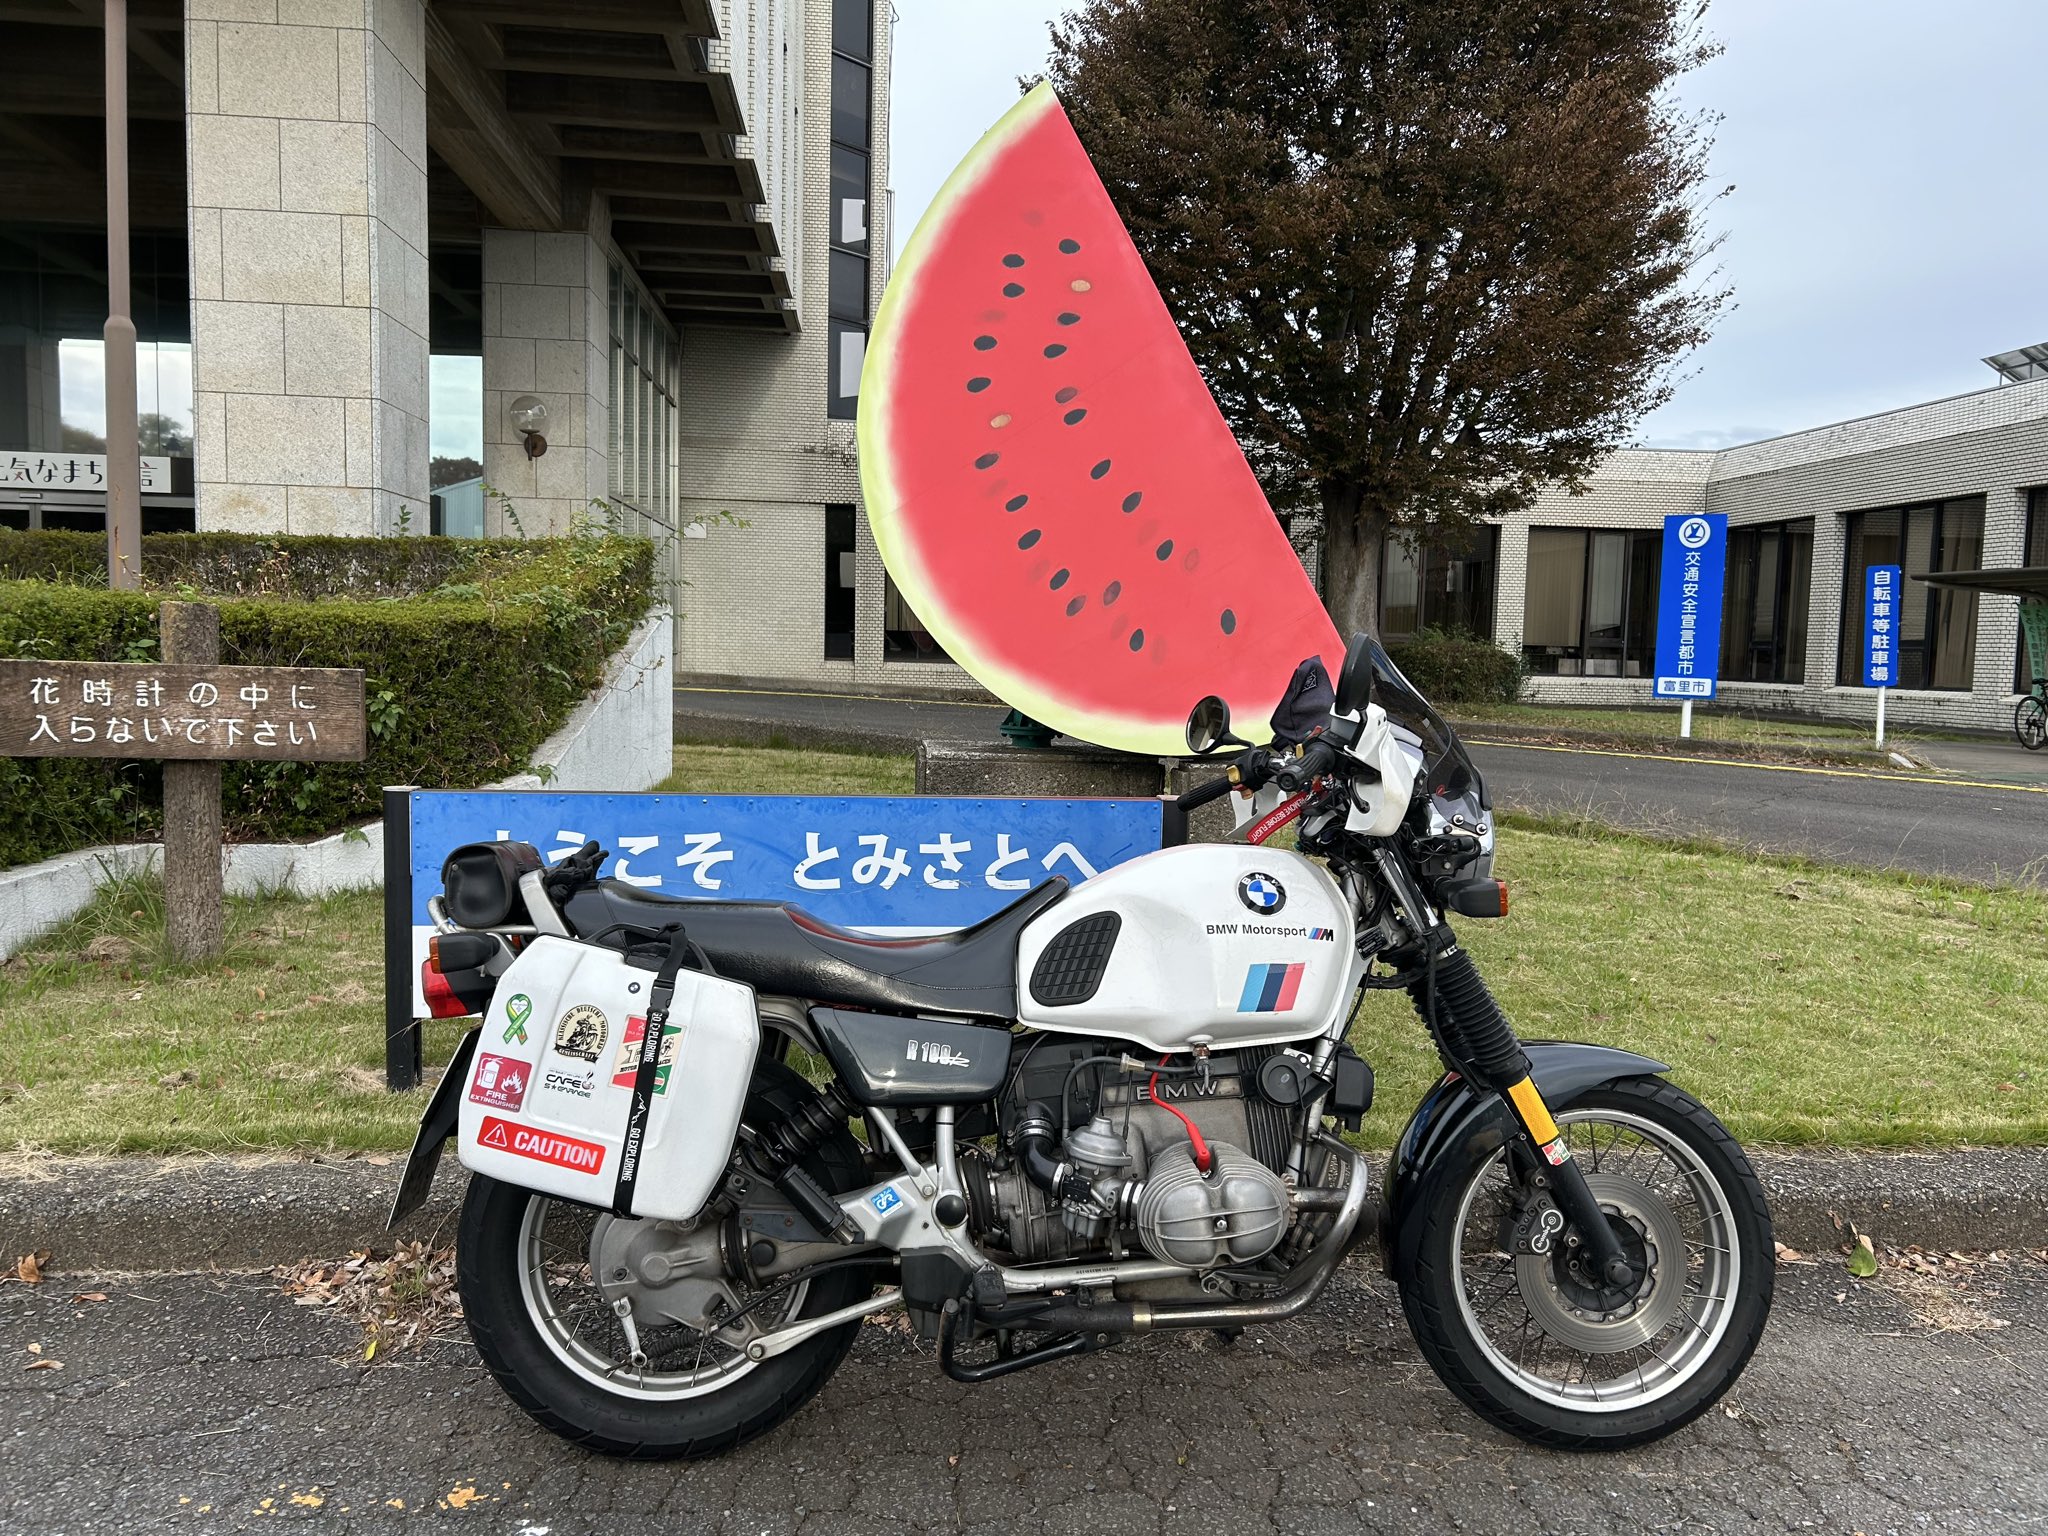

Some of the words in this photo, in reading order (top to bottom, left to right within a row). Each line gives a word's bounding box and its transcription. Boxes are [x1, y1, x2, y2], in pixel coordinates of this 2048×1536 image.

[1677, 551, 1701, 675] 交通安全宣言都市
[1870, 570, 1891, 681] 自転車等駐車場
[30, 678, 317, 710] 花時計の中に
[1663, 680, 1706, 694] 富里市
[29, 714, 317, 747] 入らないで下さい
[1265, 809, 1287, 829] BEFORE
[1250, 823, 1269, 843] FLIGHT
[792, 831, 1099, 890] とみさとへ
[1206, 924, 1238, 935] BMW
[1242, 924, 1307, 938] Motorsport
[546, 1073, 582, 1089] CAFE
[470, 1093, 520, 1110] EXTINGUISHER
[486, 1089, 508, 1101] FIRE
[630, 1127, 641, 1139] GO
[513, 1130, 599, 1169] CAUTION
[622, 1139, 639, 1181] EXPLORING
[1535, 1225, 1551, 1248] brembo
